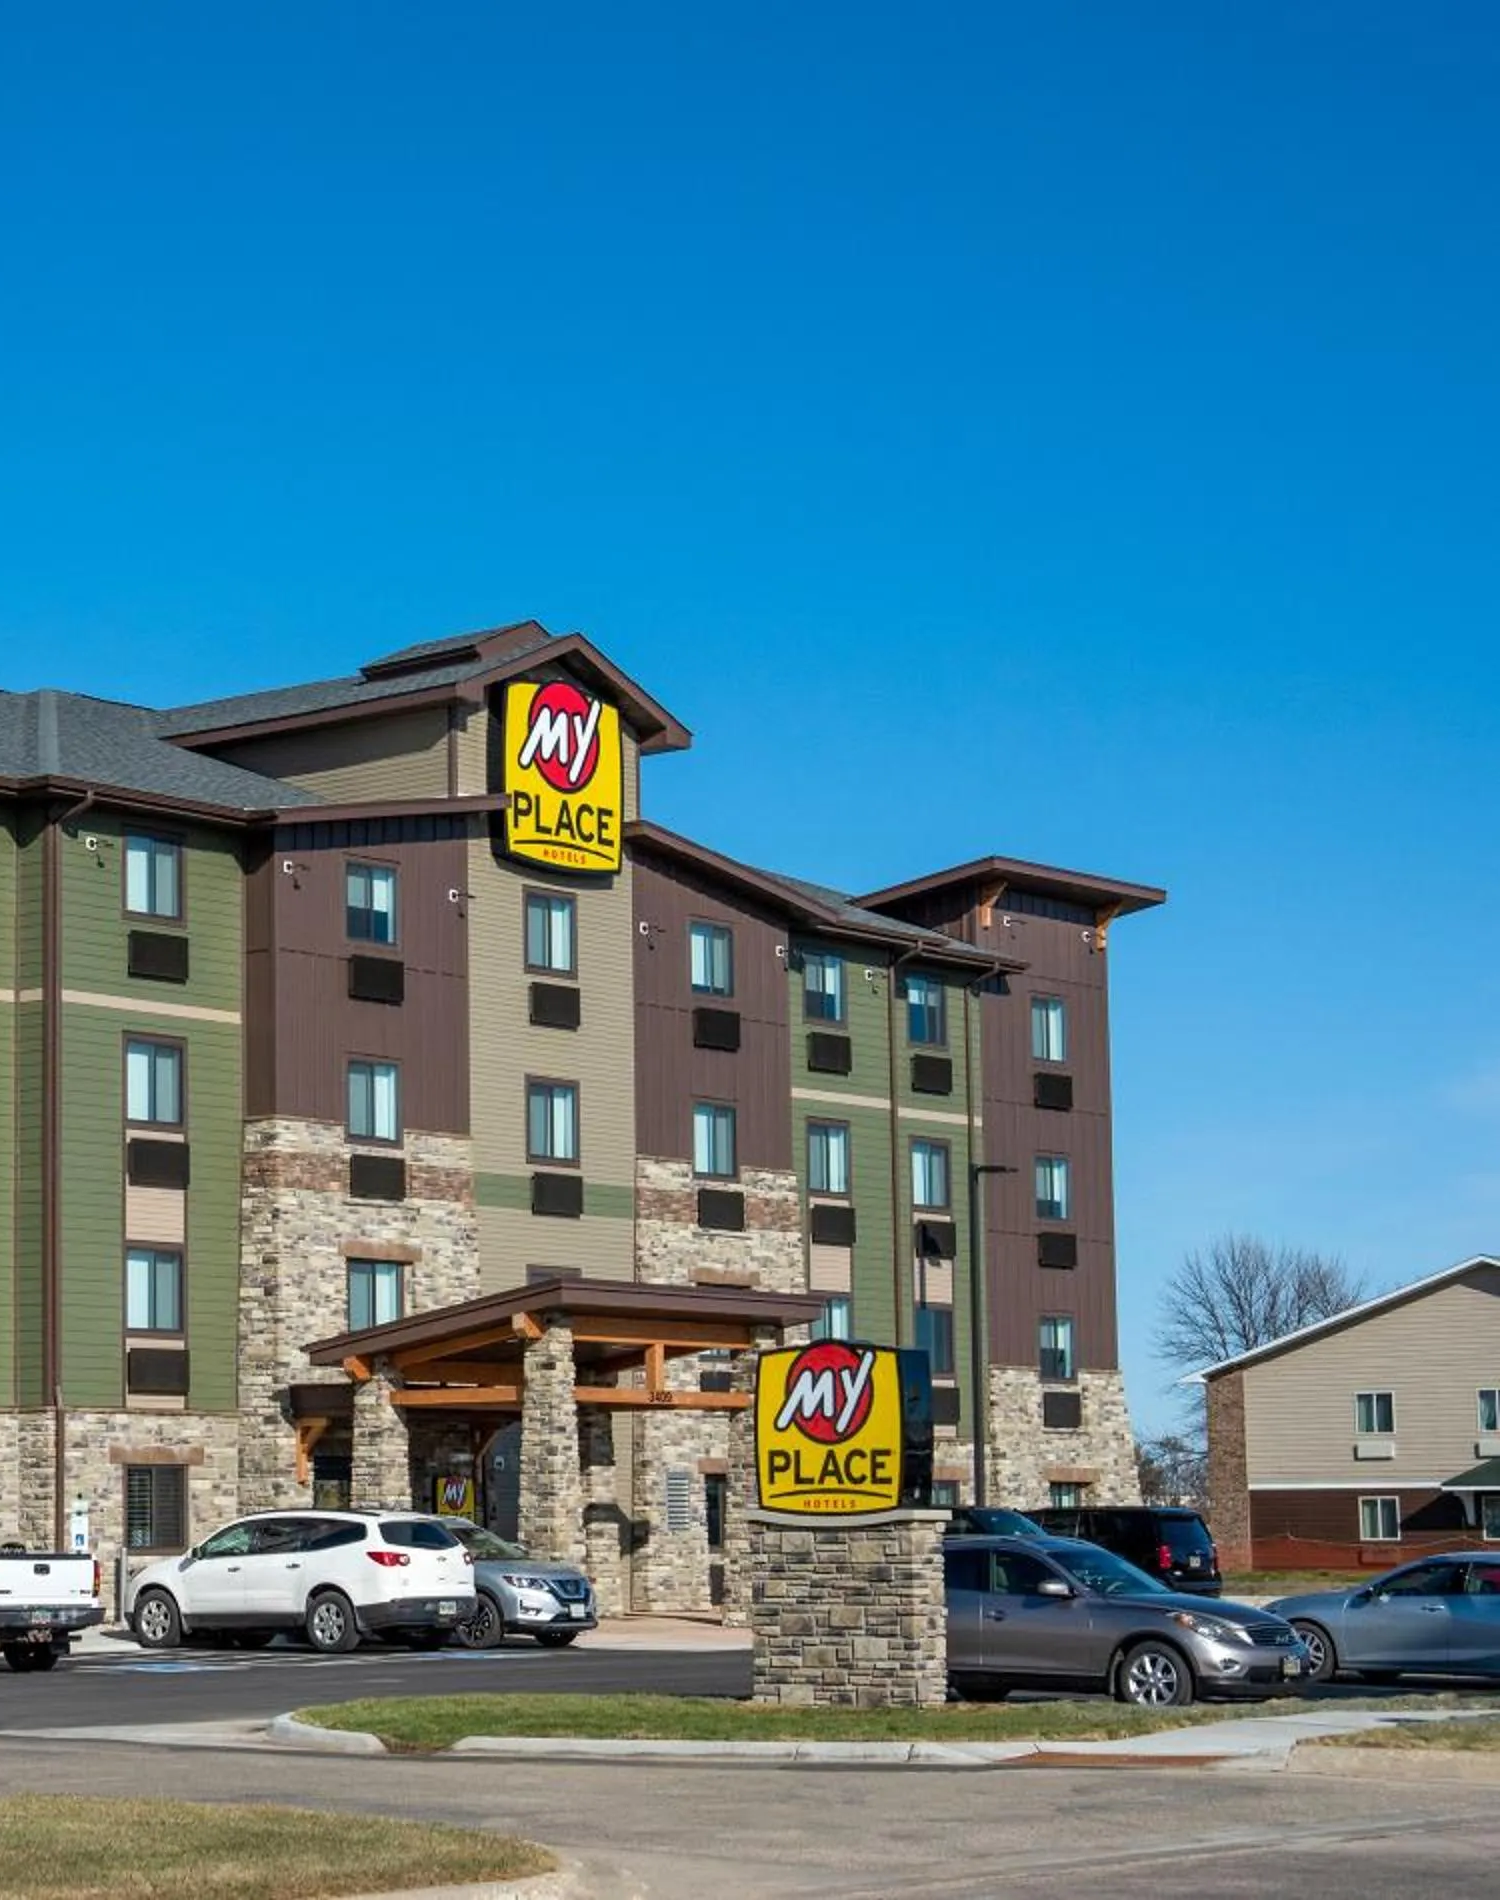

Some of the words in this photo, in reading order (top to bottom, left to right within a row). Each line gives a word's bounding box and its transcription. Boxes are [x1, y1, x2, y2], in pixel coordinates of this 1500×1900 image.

[513, 790, 615, 848] PLACE
[543, 848, 589, 866] HOTELS
[767, 1449, 893, 1486] PLACE
[803, 1499, 857, 1509] HOTELS
